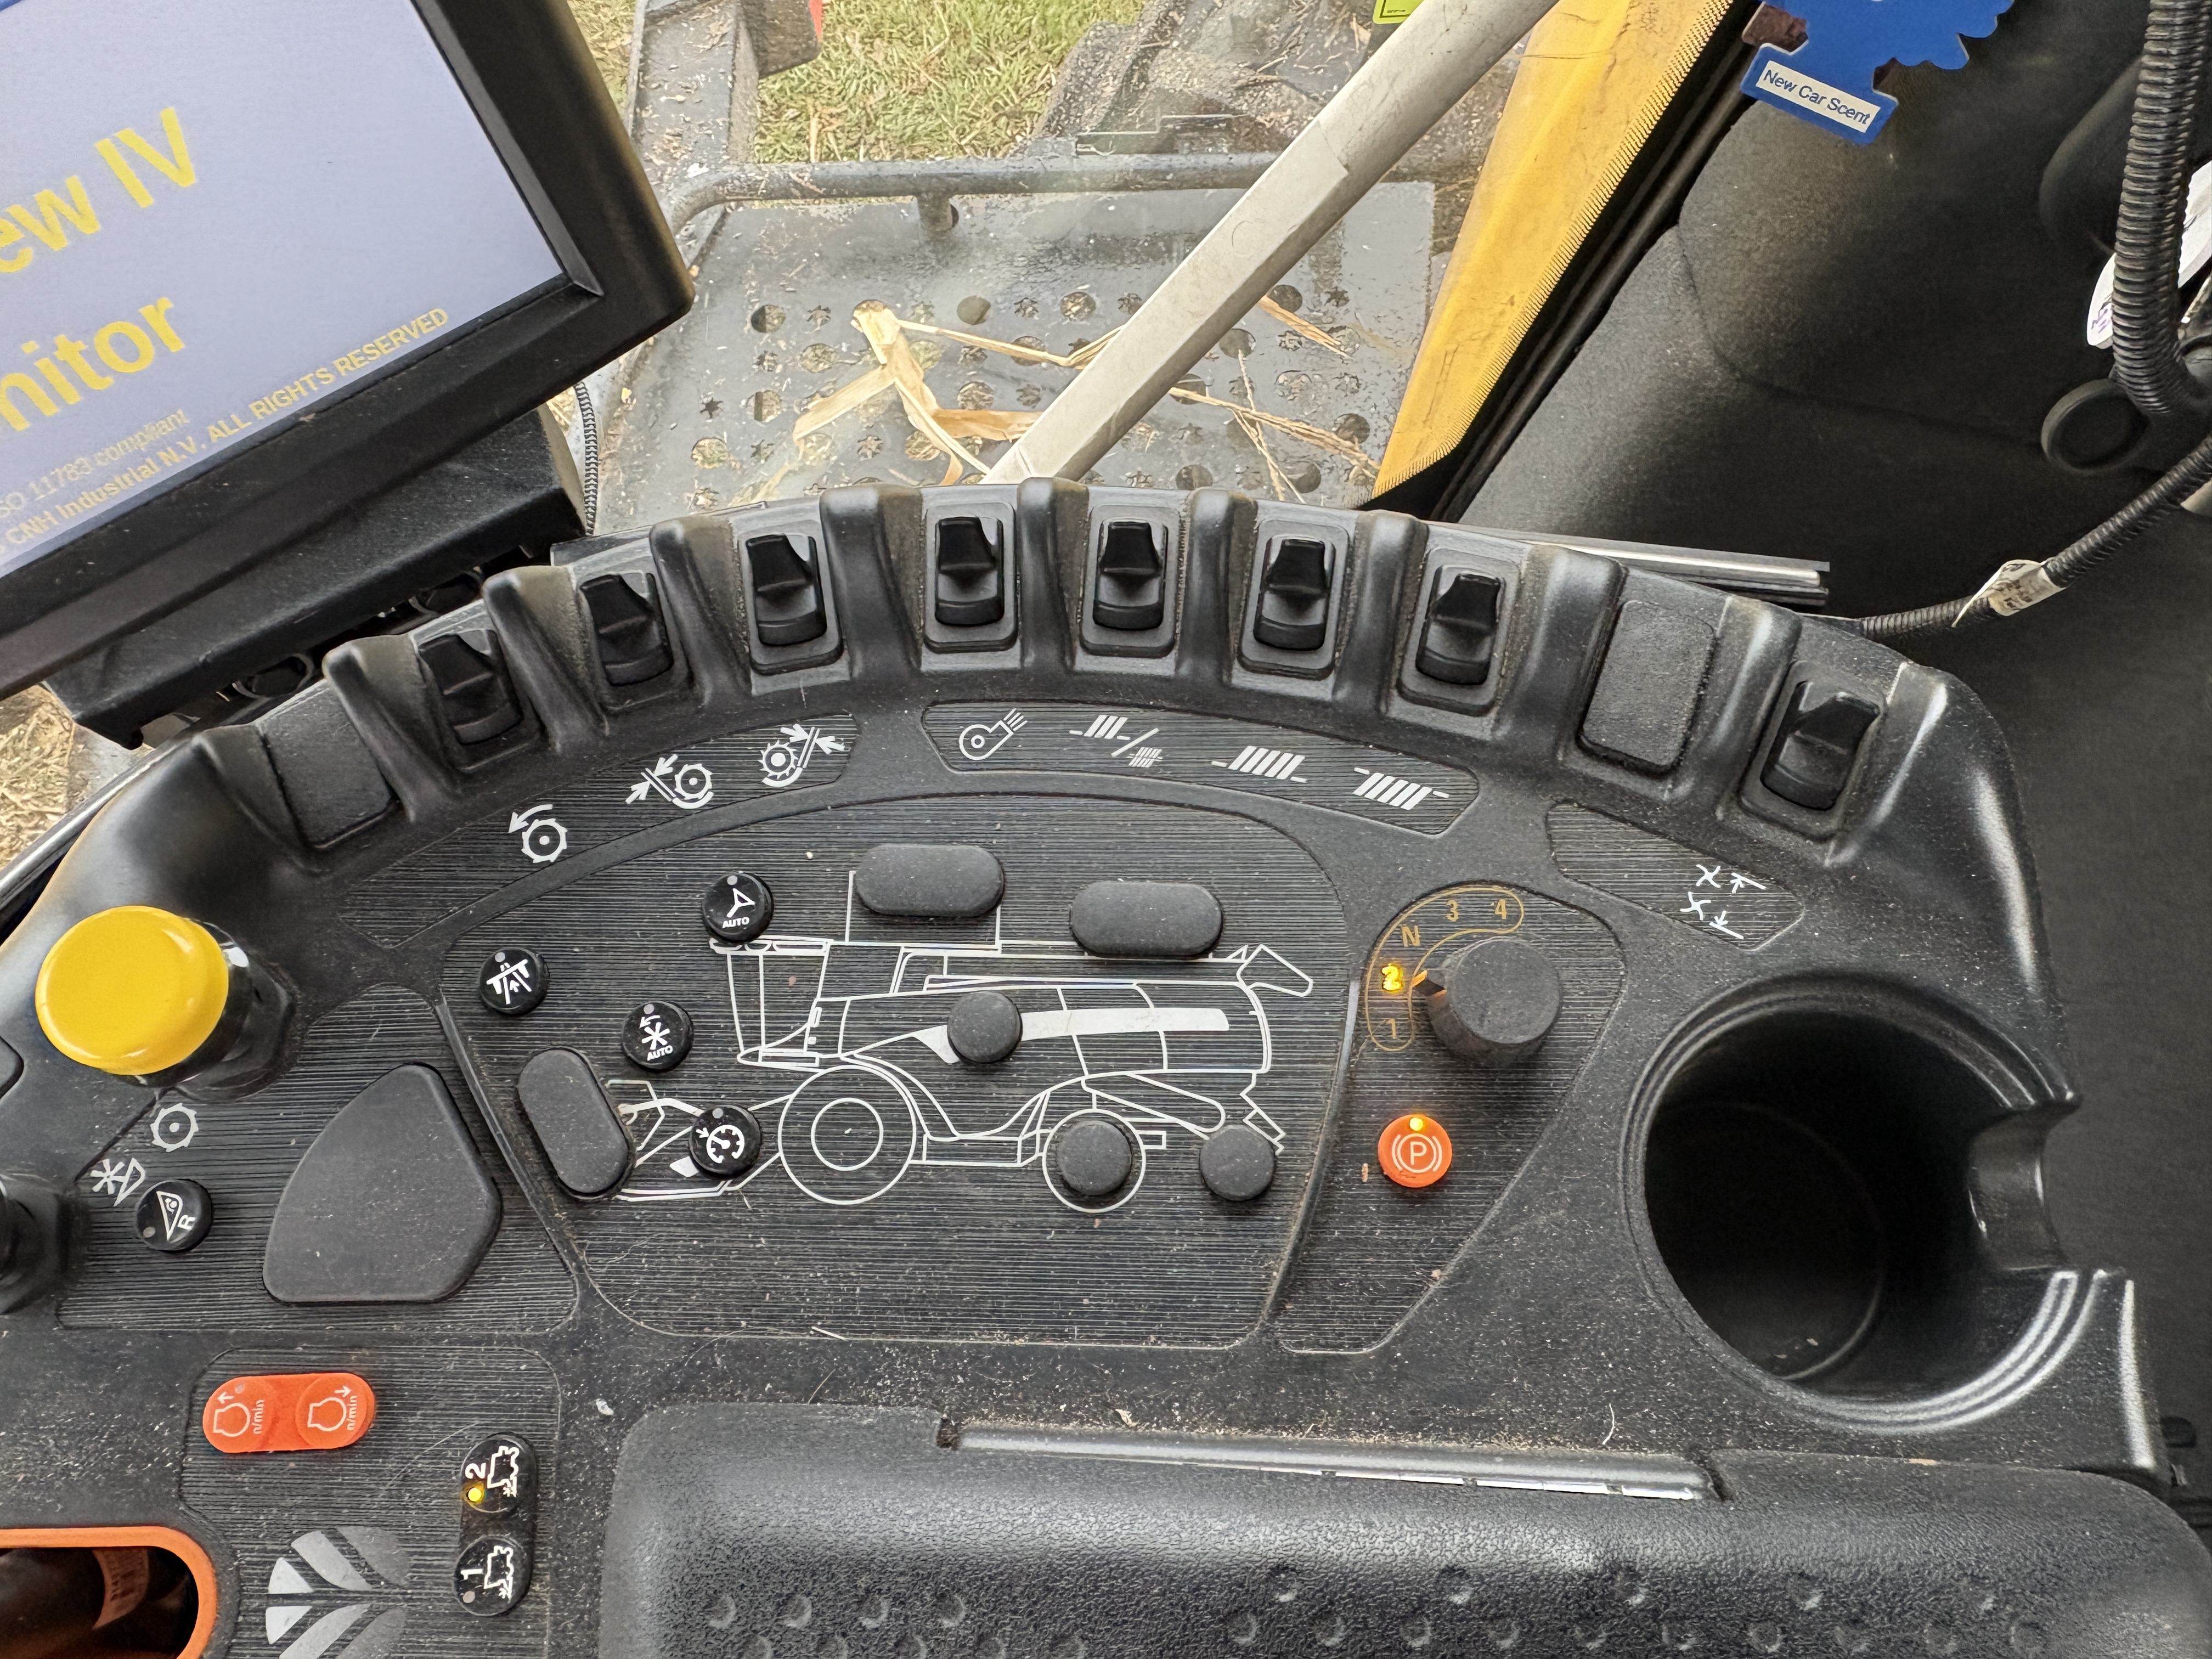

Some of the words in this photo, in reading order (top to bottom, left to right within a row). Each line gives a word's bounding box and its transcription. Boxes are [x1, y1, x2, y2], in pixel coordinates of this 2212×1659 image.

[1763, 69, 1798, 92] New
[1798, 85, 1827, 105] Car
[1827, 98, 1871, 125] Scent
[94, 106, 198, 208] IV
[5, 510, 59, 544] CNH
[55, 457, 161, 519] Industrial
[157, 436, 207, 467] N.V.
[206, 414, 252, 443] ALL
[248, 367, 336, 420] RIGHTS
[332, 307, 449, 376] RESERVED
[29, 456, 93, 501] 11783
[94, 408, 190, 466] compliant
[1445, 899, 1459, 922] 3
[1494, 898, 1508, 920] 4
[722, 917, 750, 928] AUTO
[1401, 924, 1421, 947] N
[1381, 963, 1404, 991] 2
[1388, 1018, 1397, 1040] 1
[647, 1045, 674, 1061] AUTO
[1409, 1141, 1427, 1165] P
[177, 1214, 196, 1231] R
[465, 1462, 487, 1480] 2
[460, 1568, 484, 1581] 1
